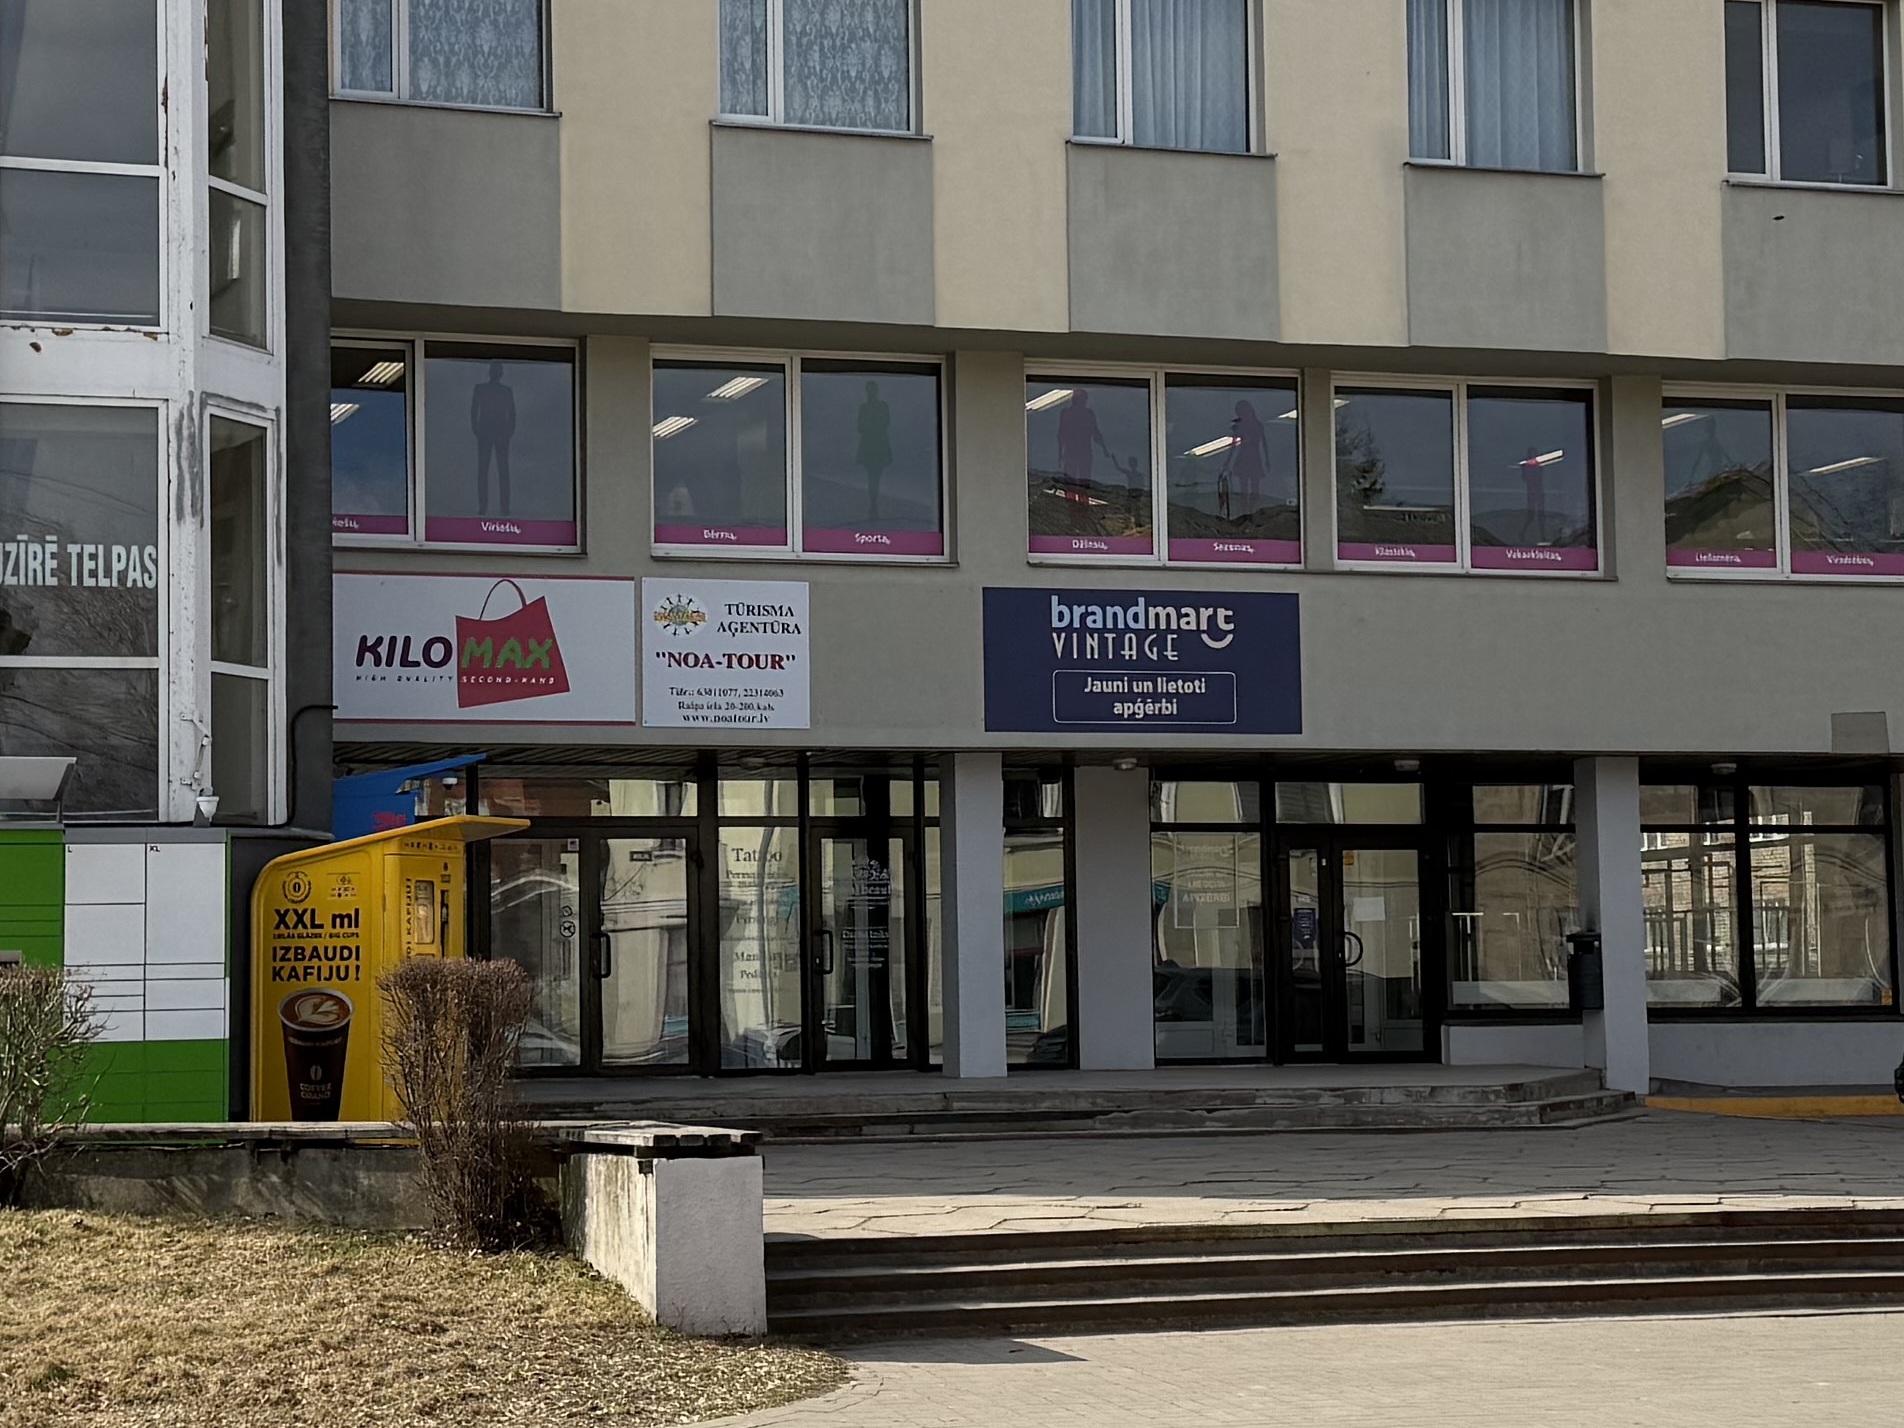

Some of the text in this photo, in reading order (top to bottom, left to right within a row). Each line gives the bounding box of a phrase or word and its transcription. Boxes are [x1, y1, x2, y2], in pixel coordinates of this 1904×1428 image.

[67, 543, 157, 589] TELPAS
[724, 602, 794, 618] TŪRISMA
[1050, 594, 1235, 632] brandmart
[717, 620, 801, 637] AĢENTŪRA
[1052, 632, 1179, 661] VINTAGE
[655, 651, 796, 670] "NOA-TOUR"
[1084, 676, 1206, 694] Jauni un lietoti
[1113, 698, 1178, 719] apģērbi
[273, 907, 360, 930] XXL ml
[272, 945, 360, 962] IZBAUDI
